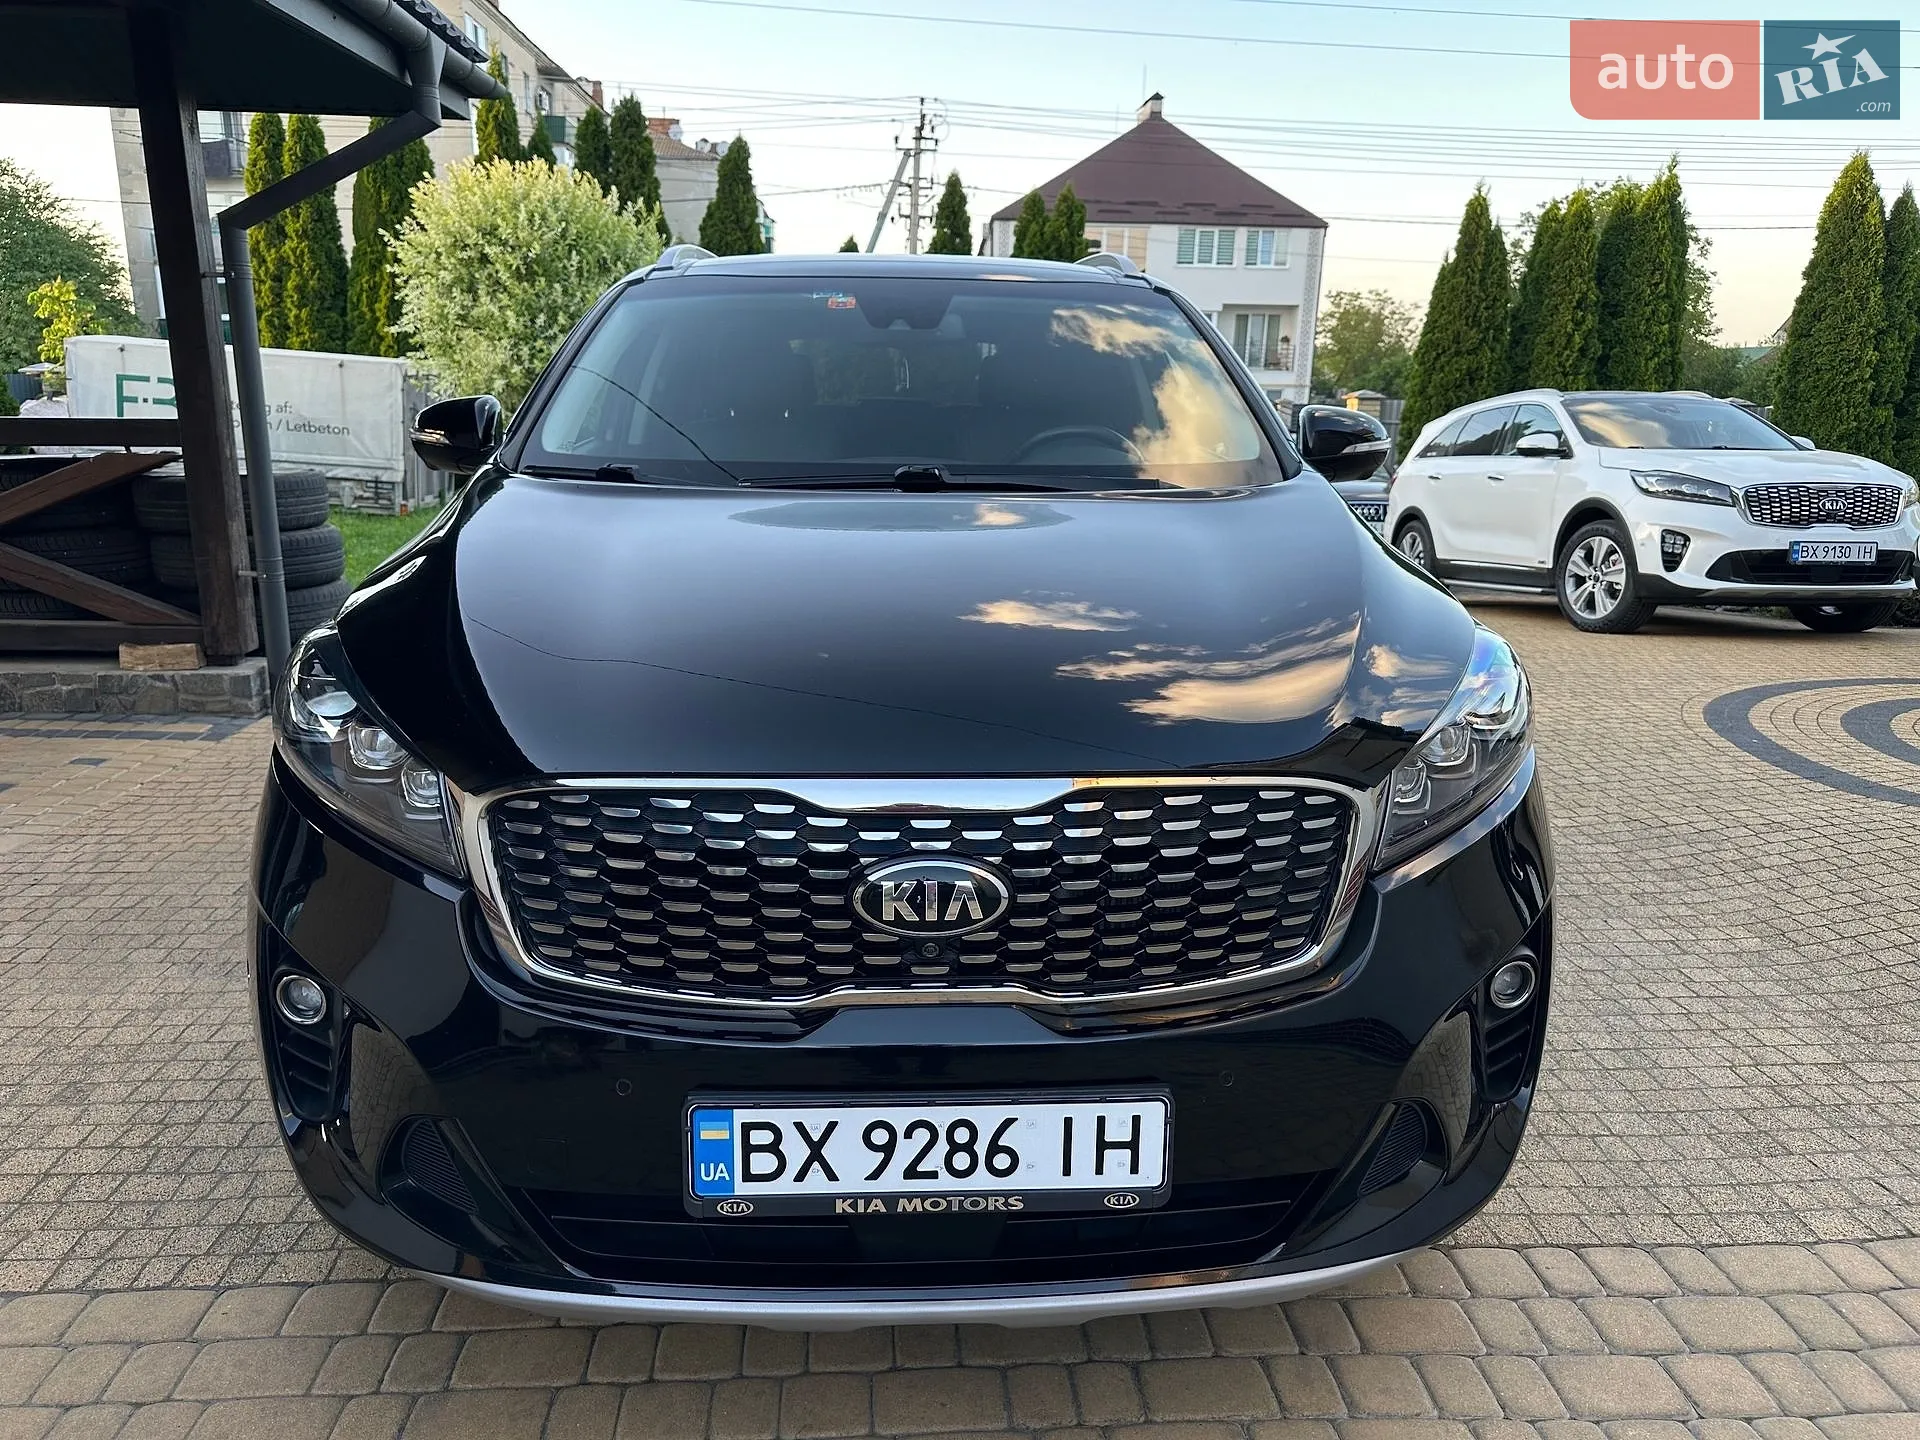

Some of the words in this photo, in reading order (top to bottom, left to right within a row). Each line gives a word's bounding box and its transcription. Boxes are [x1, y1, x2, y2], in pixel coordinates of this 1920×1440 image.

[286, 420, 350, 436] Letbeton
[1825, 500, 1844, 510] KIA
[1800, 545, 1819, 559] BX
[1822, 545, 1852, 559] 9130
[1857, 545, 1873, 559] IH
[881, 880, 984, 921] KIA
[740, 1120, 840, 1183] BX
[861, 1117, 1020, 1181] 9286
[1062, 1114, 1141, 1177] IH
[700, 1162, 730, 1181] UA
[722, 1202, 748, 1214] KIA
[834, 1198, 887, 1214] KIA
[896, 1196, 1025, 1213] MOTORS
[1110, 1195, 1135, 1206] KIA
